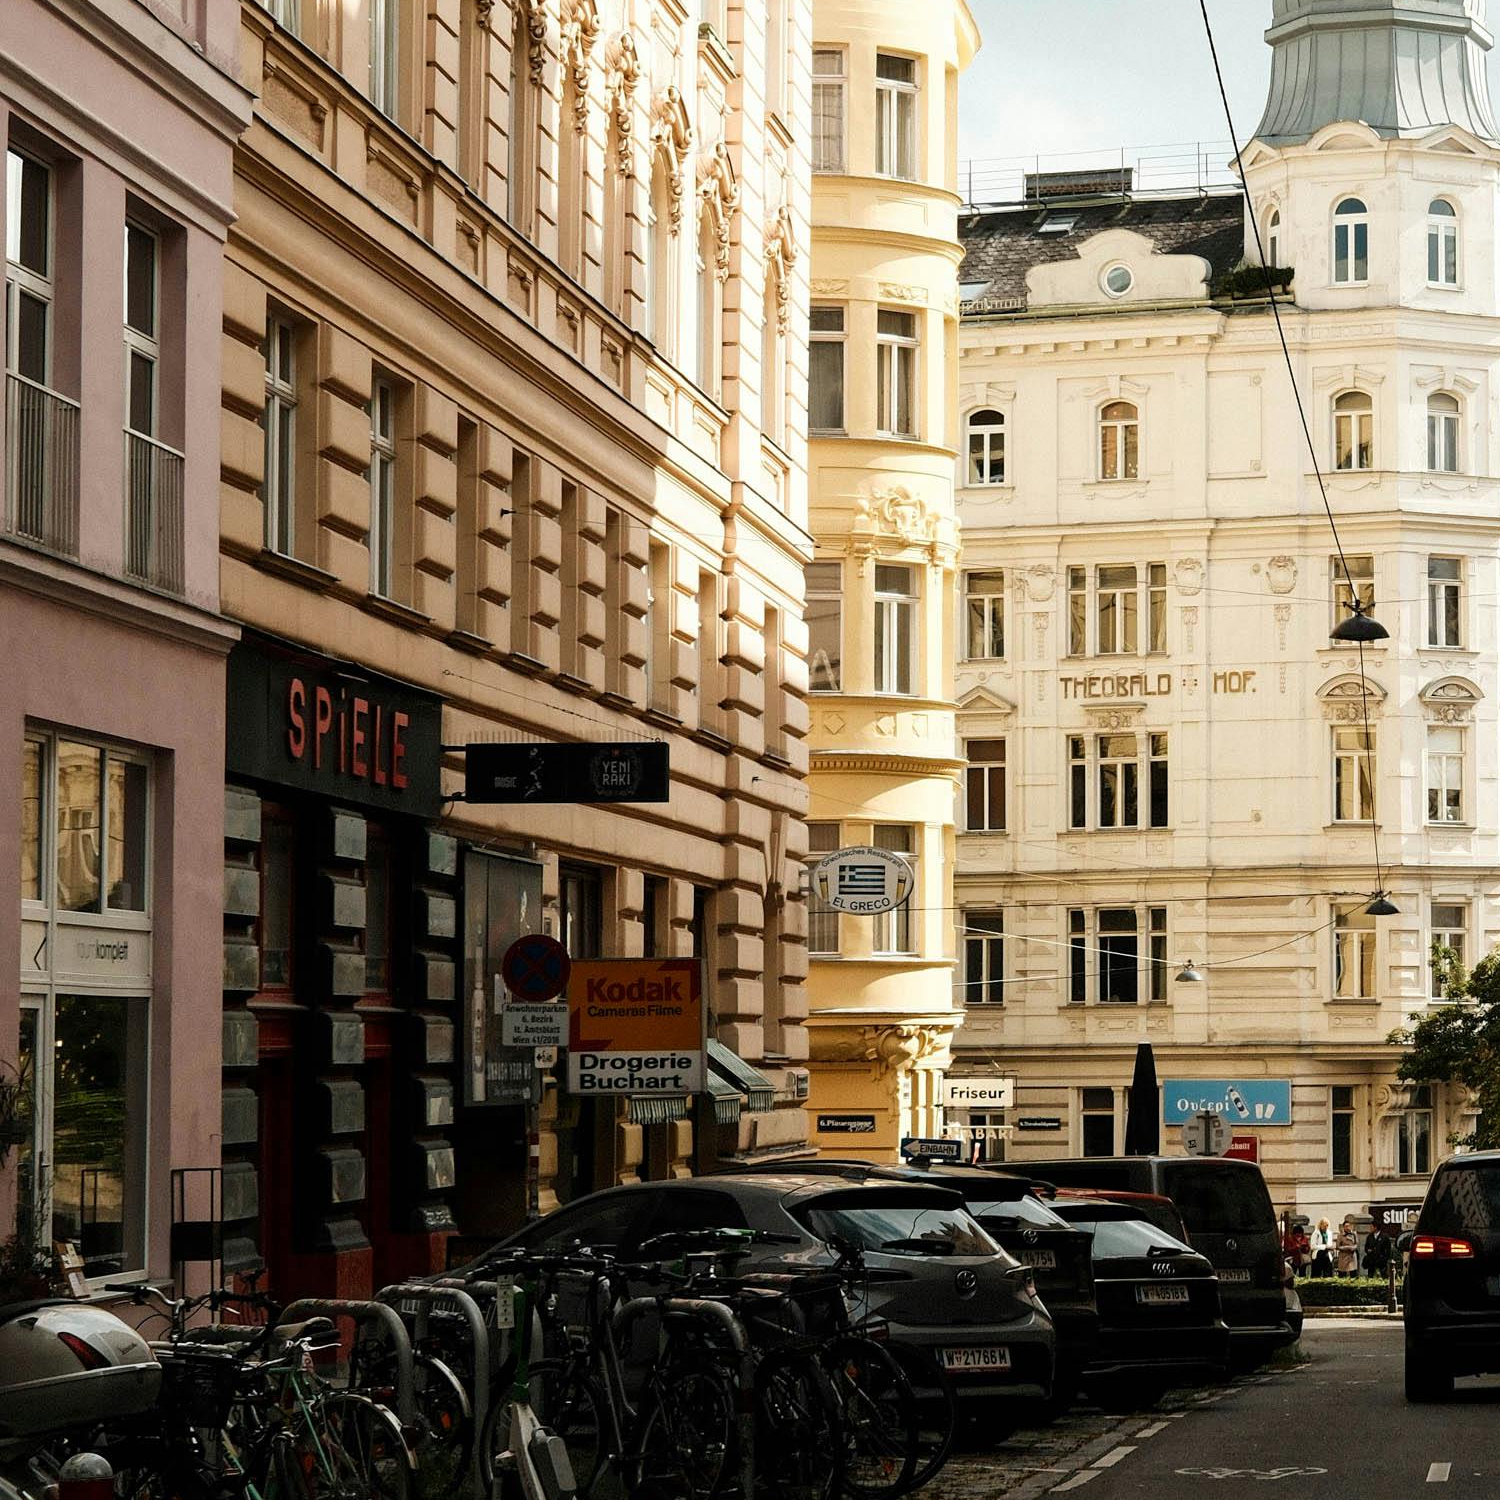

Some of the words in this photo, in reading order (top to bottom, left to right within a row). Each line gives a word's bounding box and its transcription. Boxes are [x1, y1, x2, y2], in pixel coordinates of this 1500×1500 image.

[1060, 673, 1171, 699] THEOBALD
[602, 773, 631, 786] RAKI
[832, 896, 846, 909] EL
[849, 897, 891, 911] GRECO
[586, 976, 683, 1003] Kodak
[505, 1004, 567, 1013] Anwohnerparken
[647, 1004, 683, 1016] Filme
[531, 1015, 554, 1023] Bezirk
[513, 1036, 530, 1044] Wien
[580, 1053, 692, 1072] Drogerie
[580, 1073, 683, 1089] Buchart
[950, 1086, 1005, 1099] Friseur
[919, 1144, 955, 1155] EINBAHN
